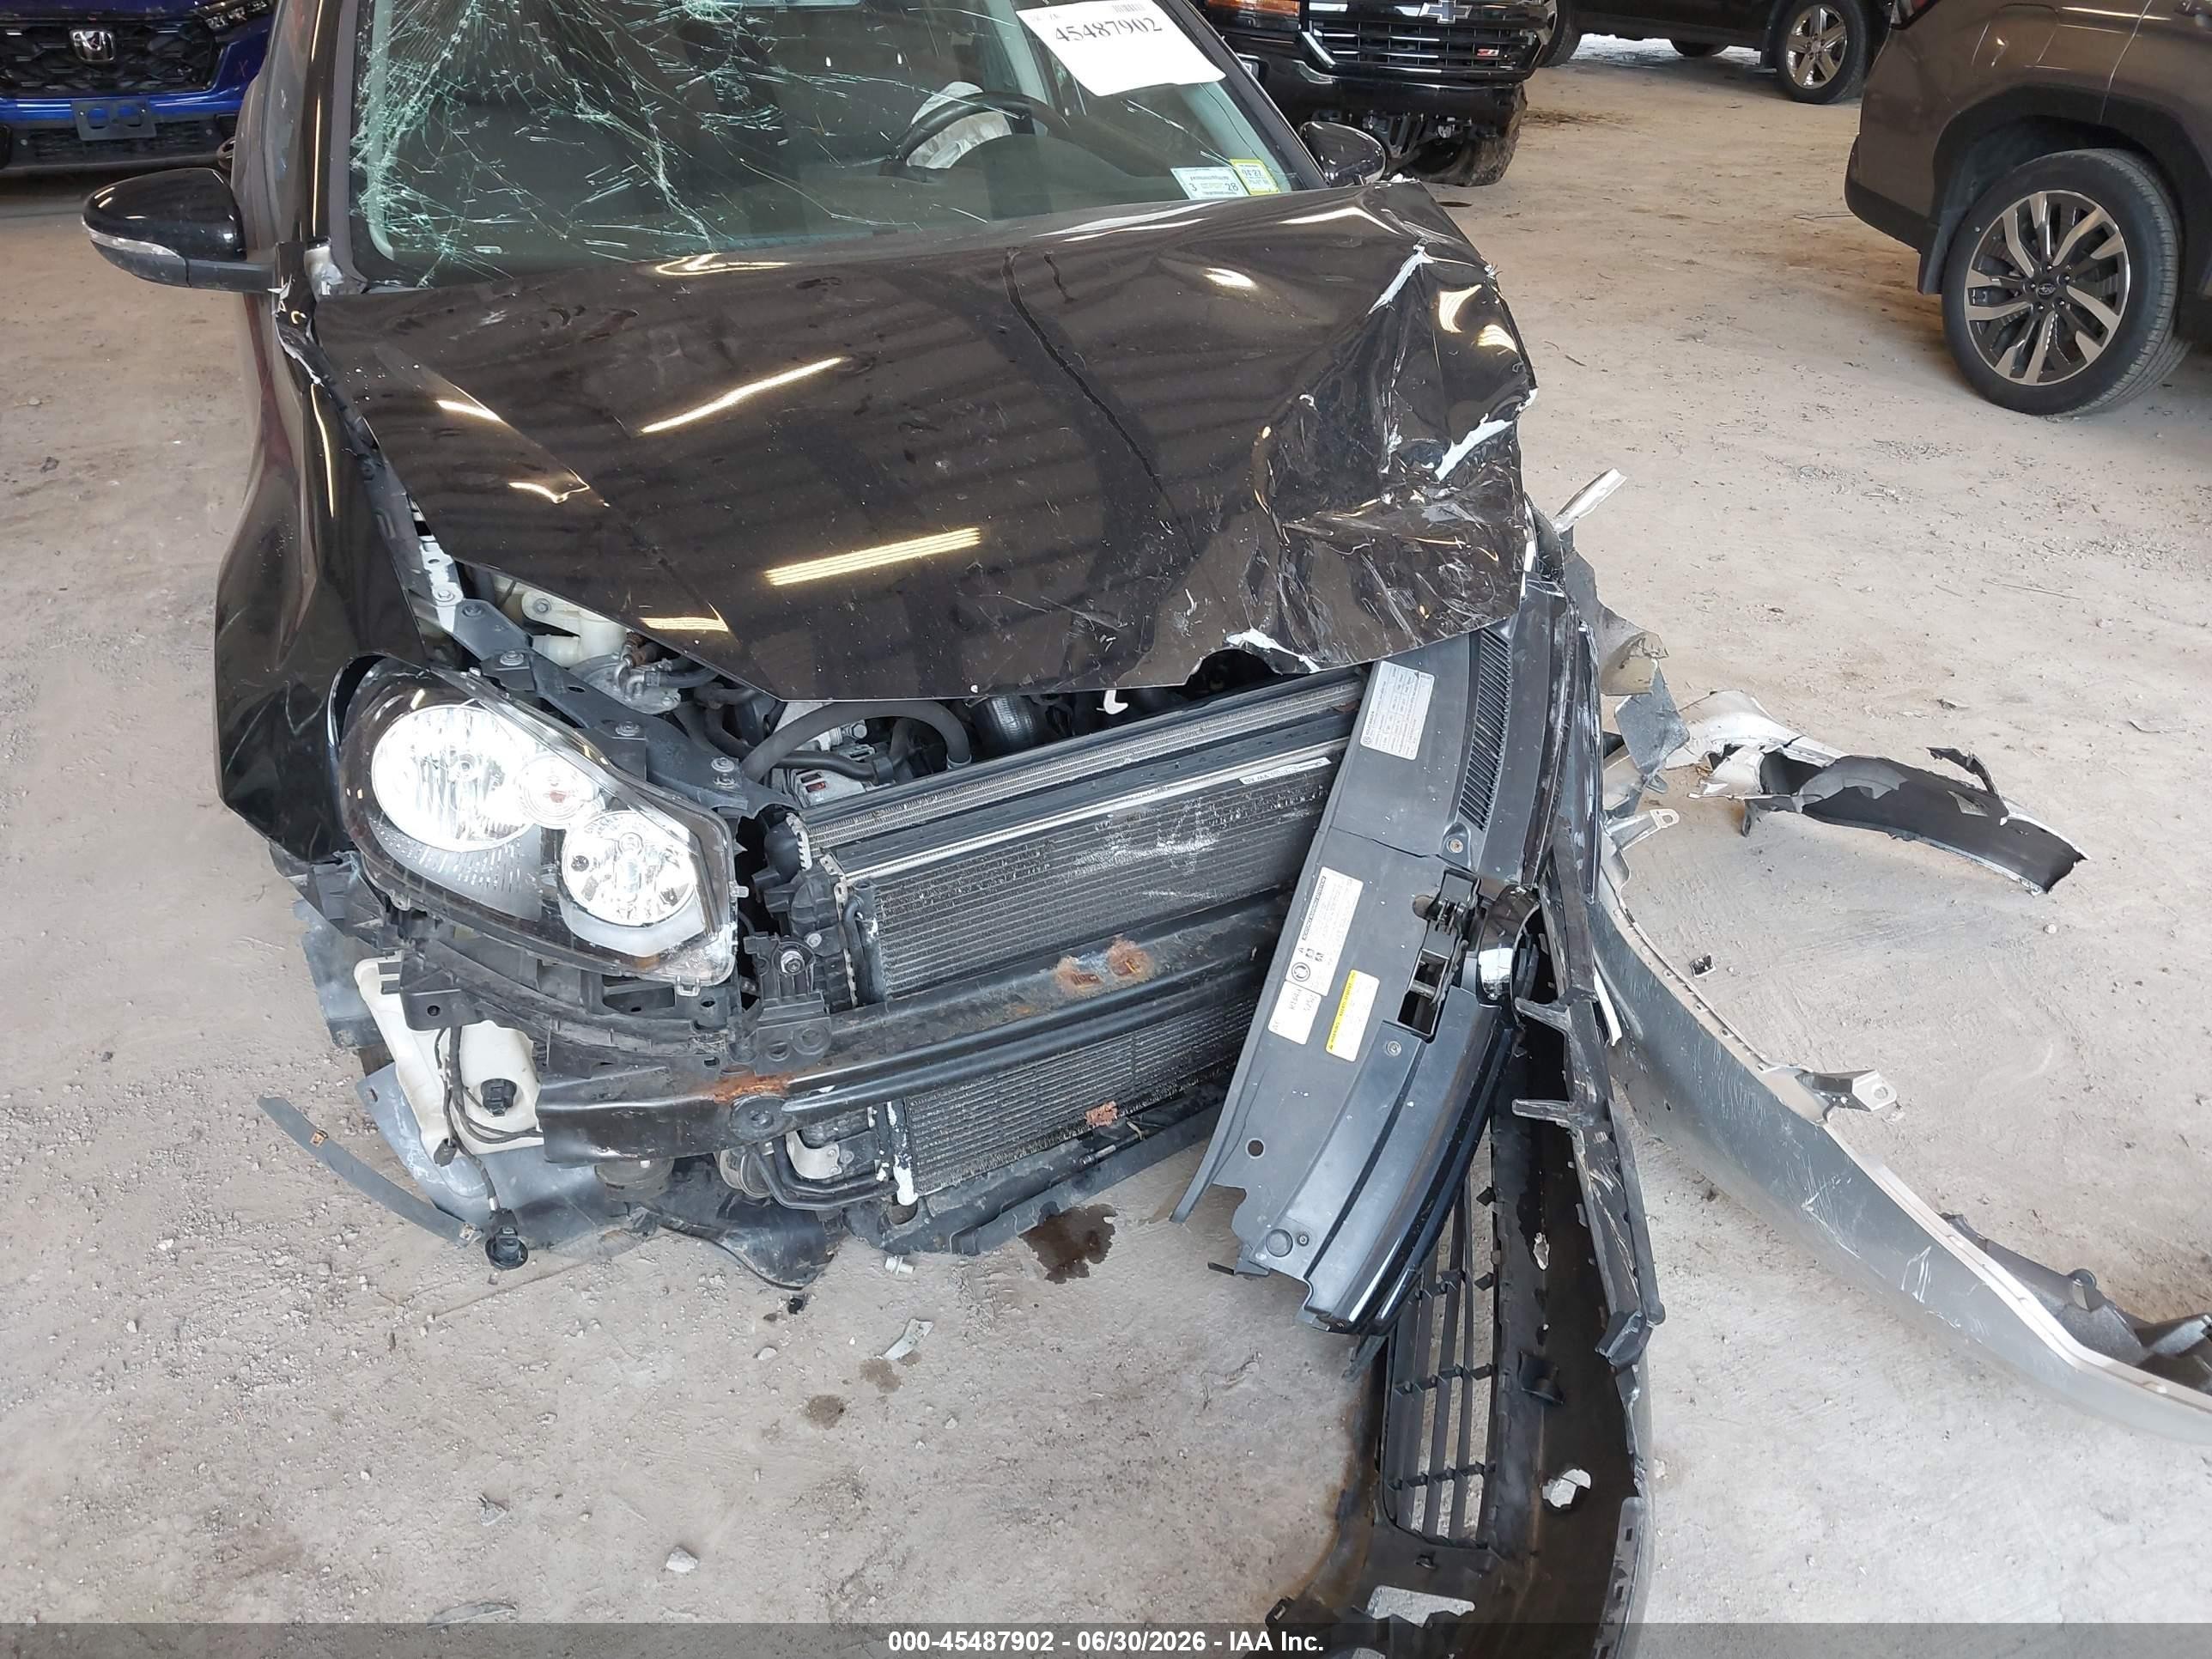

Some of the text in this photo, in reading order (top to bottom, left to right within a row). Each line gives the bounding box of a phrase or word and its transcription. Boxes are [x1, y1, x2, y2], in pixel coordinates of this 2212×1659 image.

[1055, 17, 1163, 41] 45487902
[1188, 183, 1197, 191] 3
[1224, 182, 1239, 191] 28
